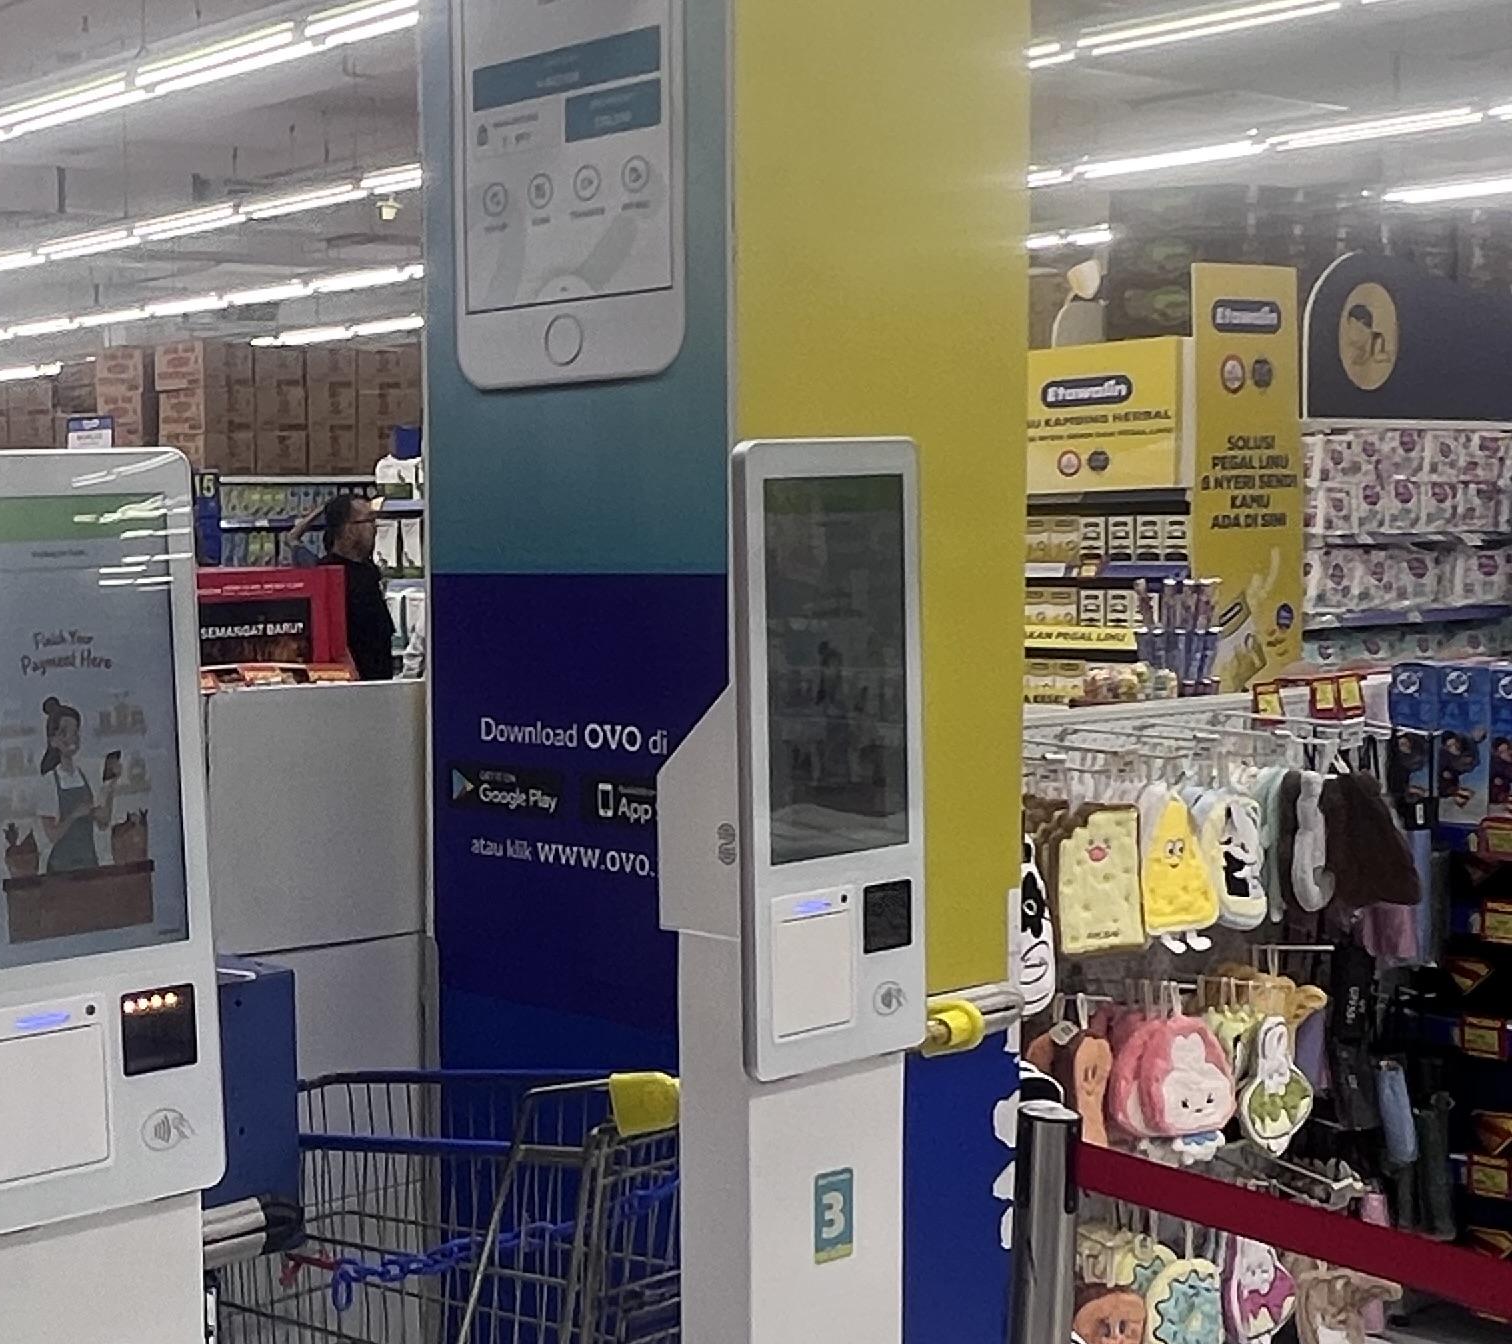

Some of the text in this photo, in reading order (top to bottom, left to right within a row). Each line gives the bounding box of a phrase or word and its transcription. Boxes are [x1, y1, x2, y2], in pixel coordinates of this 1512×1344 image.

[480, 717, 669, 756] Download OVO di
[479, 783, 558, 814] Google Play
[617, 797, 652, 824] App
[822, 1190, 846, 1239] 3
